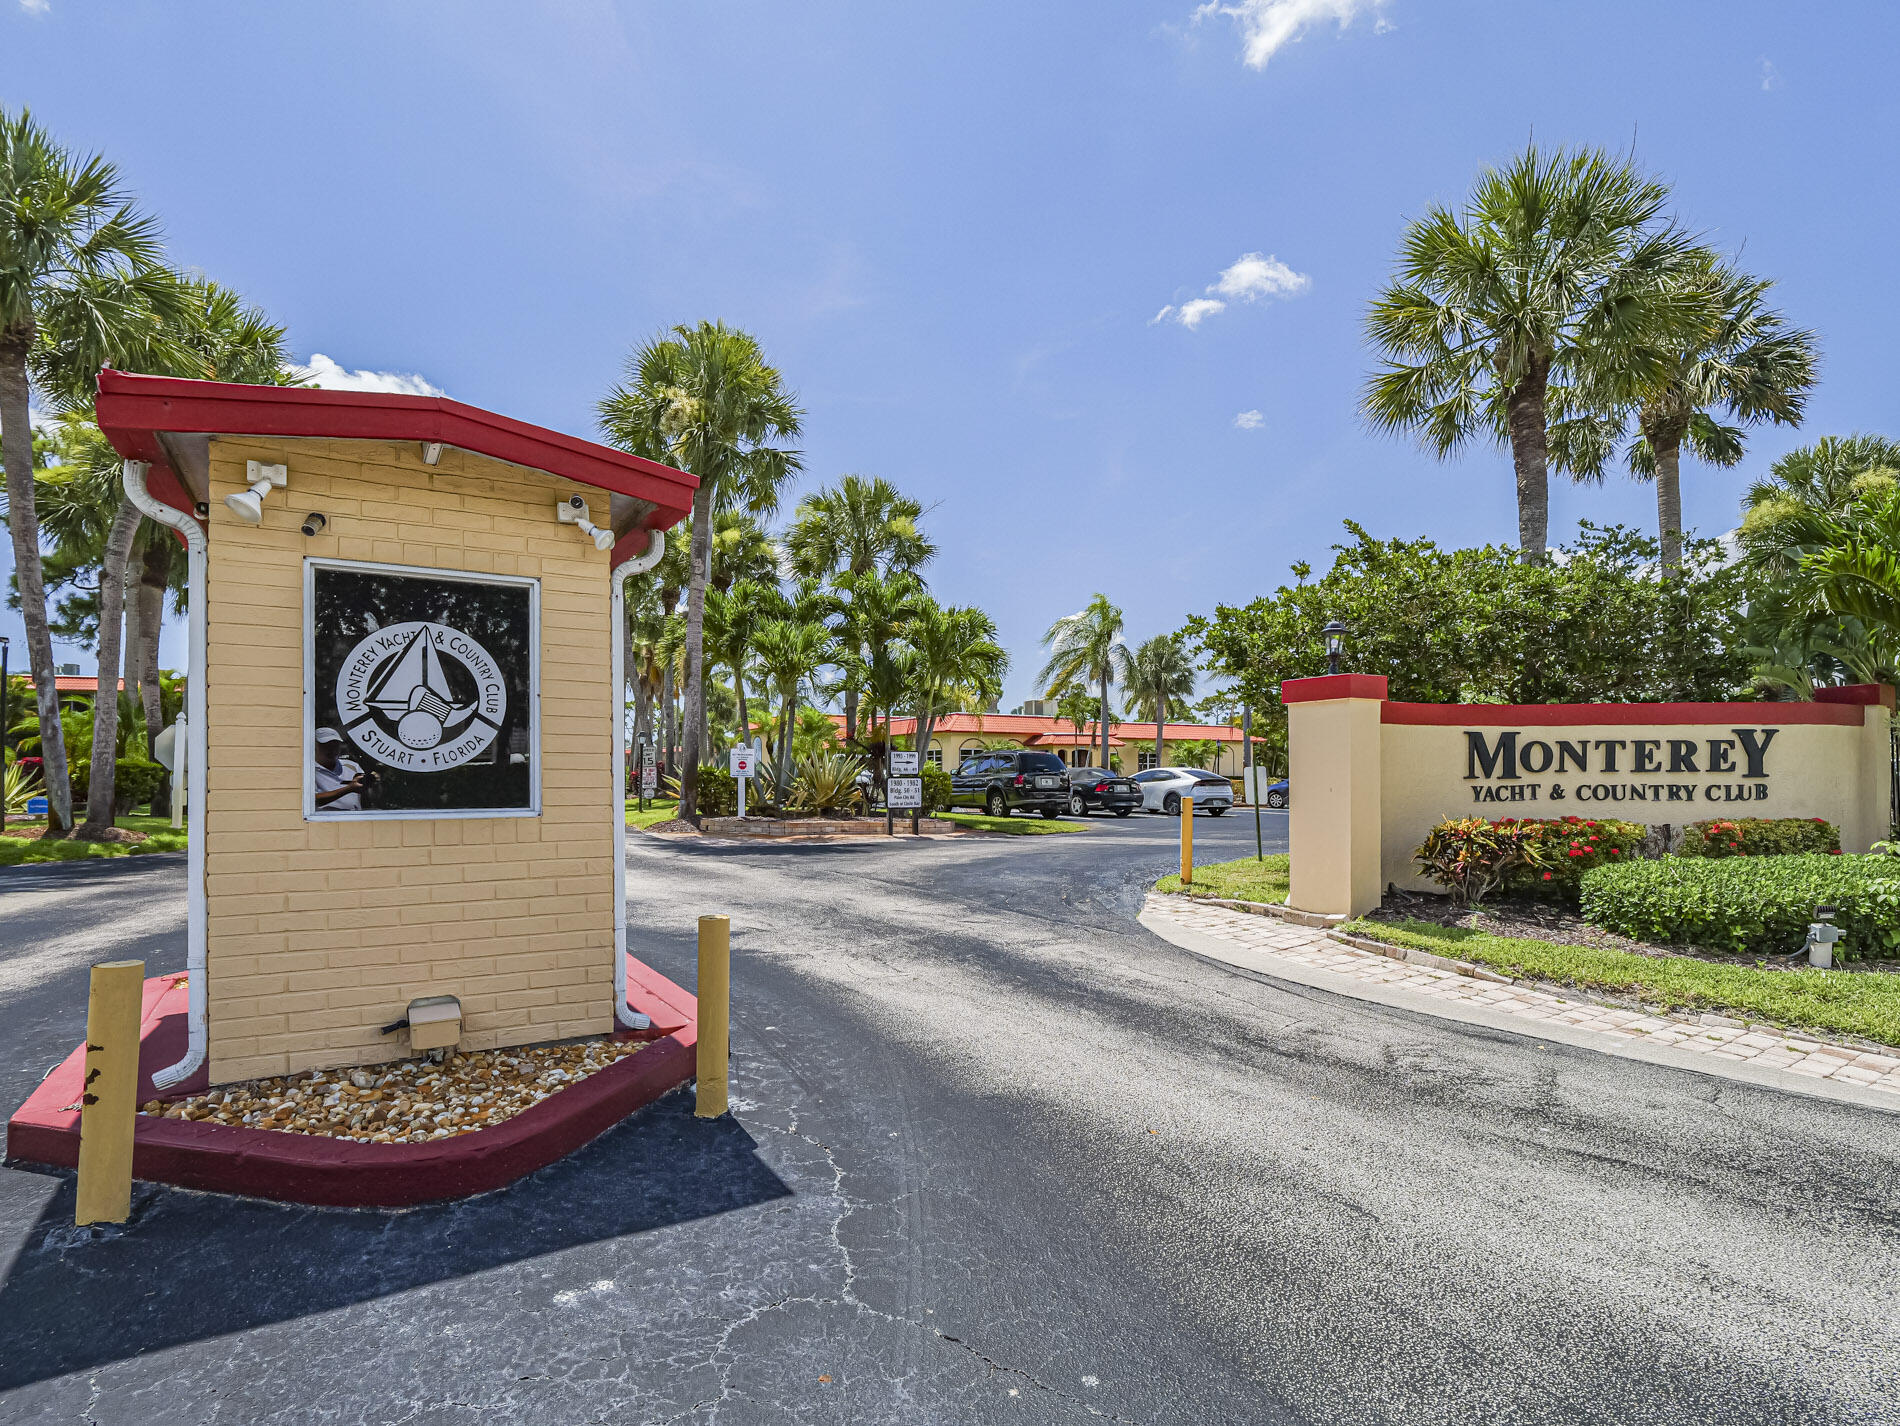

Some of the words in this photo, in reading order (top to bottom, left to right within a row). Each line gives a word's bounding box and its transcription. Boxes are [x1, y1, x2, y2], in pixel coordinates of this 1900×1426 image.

[345, 646, 379, 711] MONTEREY
[376, 631, 416, 650] YACHT
[435, 631, 445, 645] &
[450, 637, 494, 681] COUNTRY
[486, 684, 500, 714] CLUB
[362, 730, 414, 765] STUART
[433, 735, 485, 765] FLORIDA
[643, 757, 654, 765] 15
[1463, 728, 1780, 780] MONTEREY
[1471, 783, 1541, 802] YACHT
[1549, 783, 1566, 801] &
[1576, 783, 1698, 802] COUNTRY
[1704, 783, 1769, 801] CLUB
